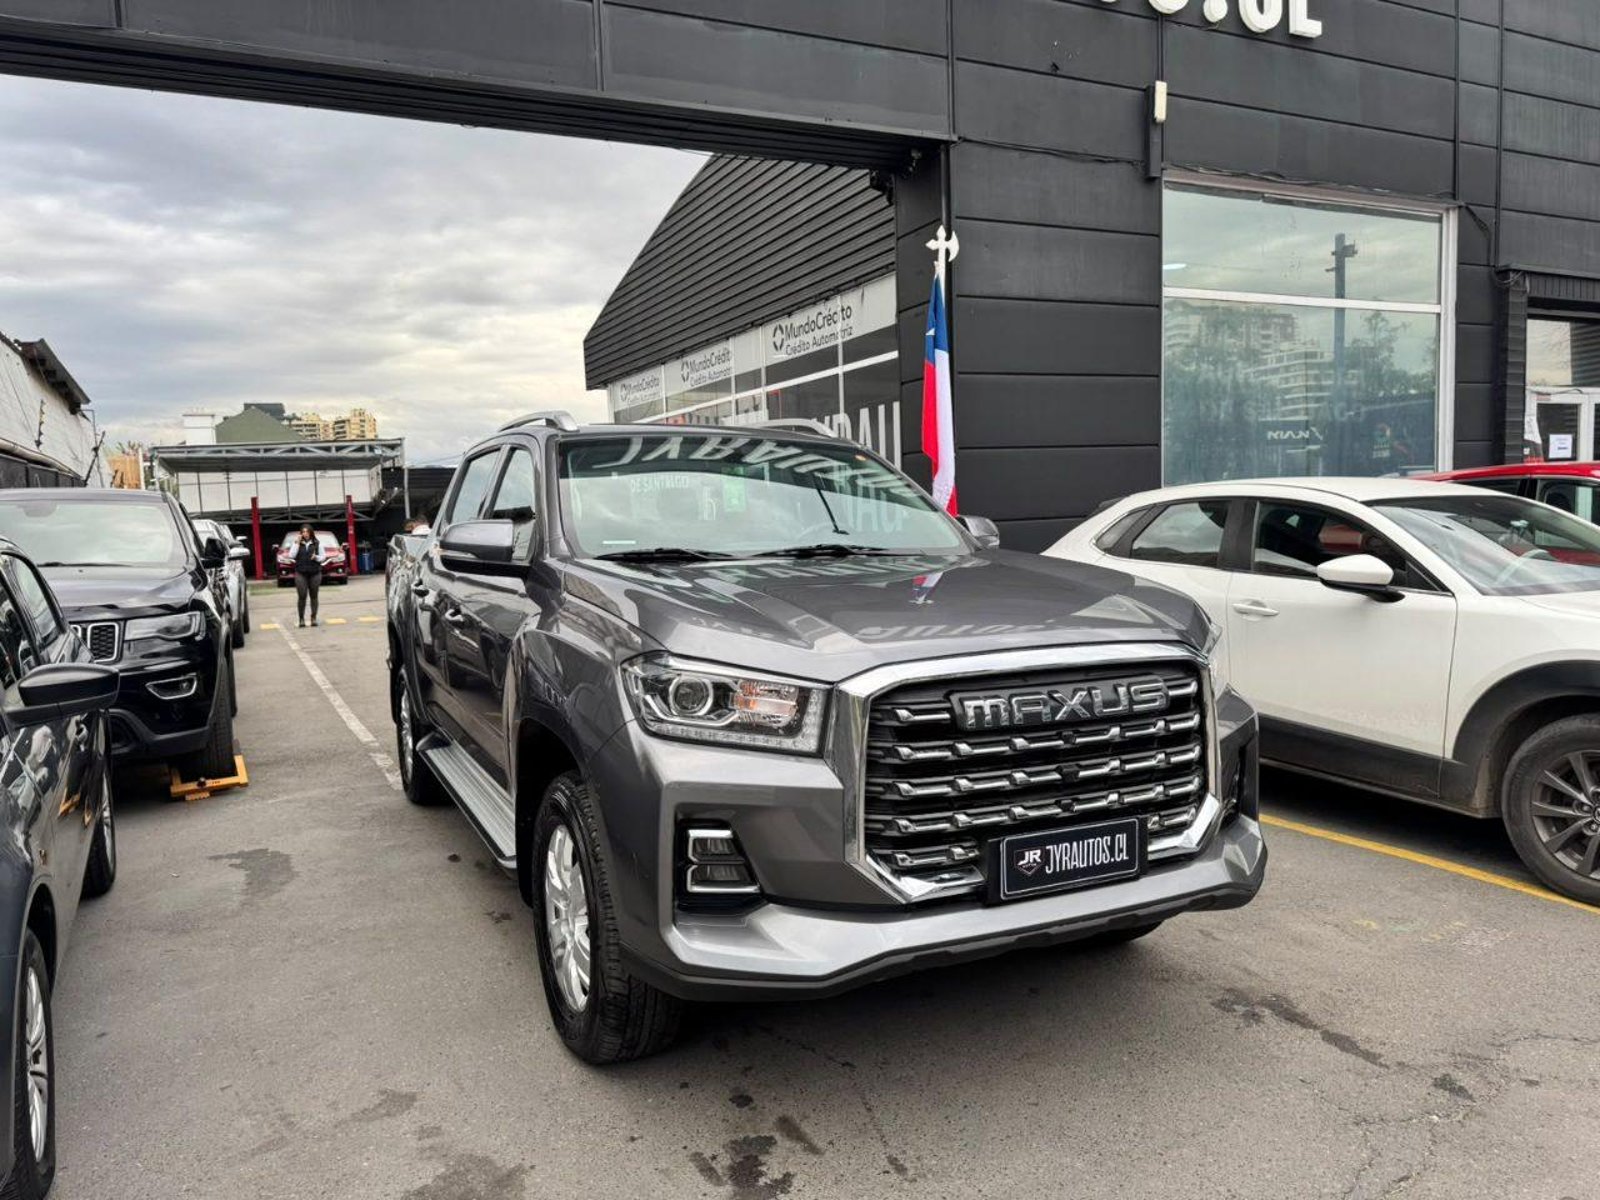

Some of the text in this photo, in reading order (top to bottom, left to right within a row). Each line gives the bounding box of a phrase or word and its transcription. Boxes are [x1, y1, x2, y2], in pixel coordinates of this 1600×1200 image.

[963, 680, 1169, 728] MAXUS
[1017, 833, 1129, 874] JR JYRAUTOS.CL
